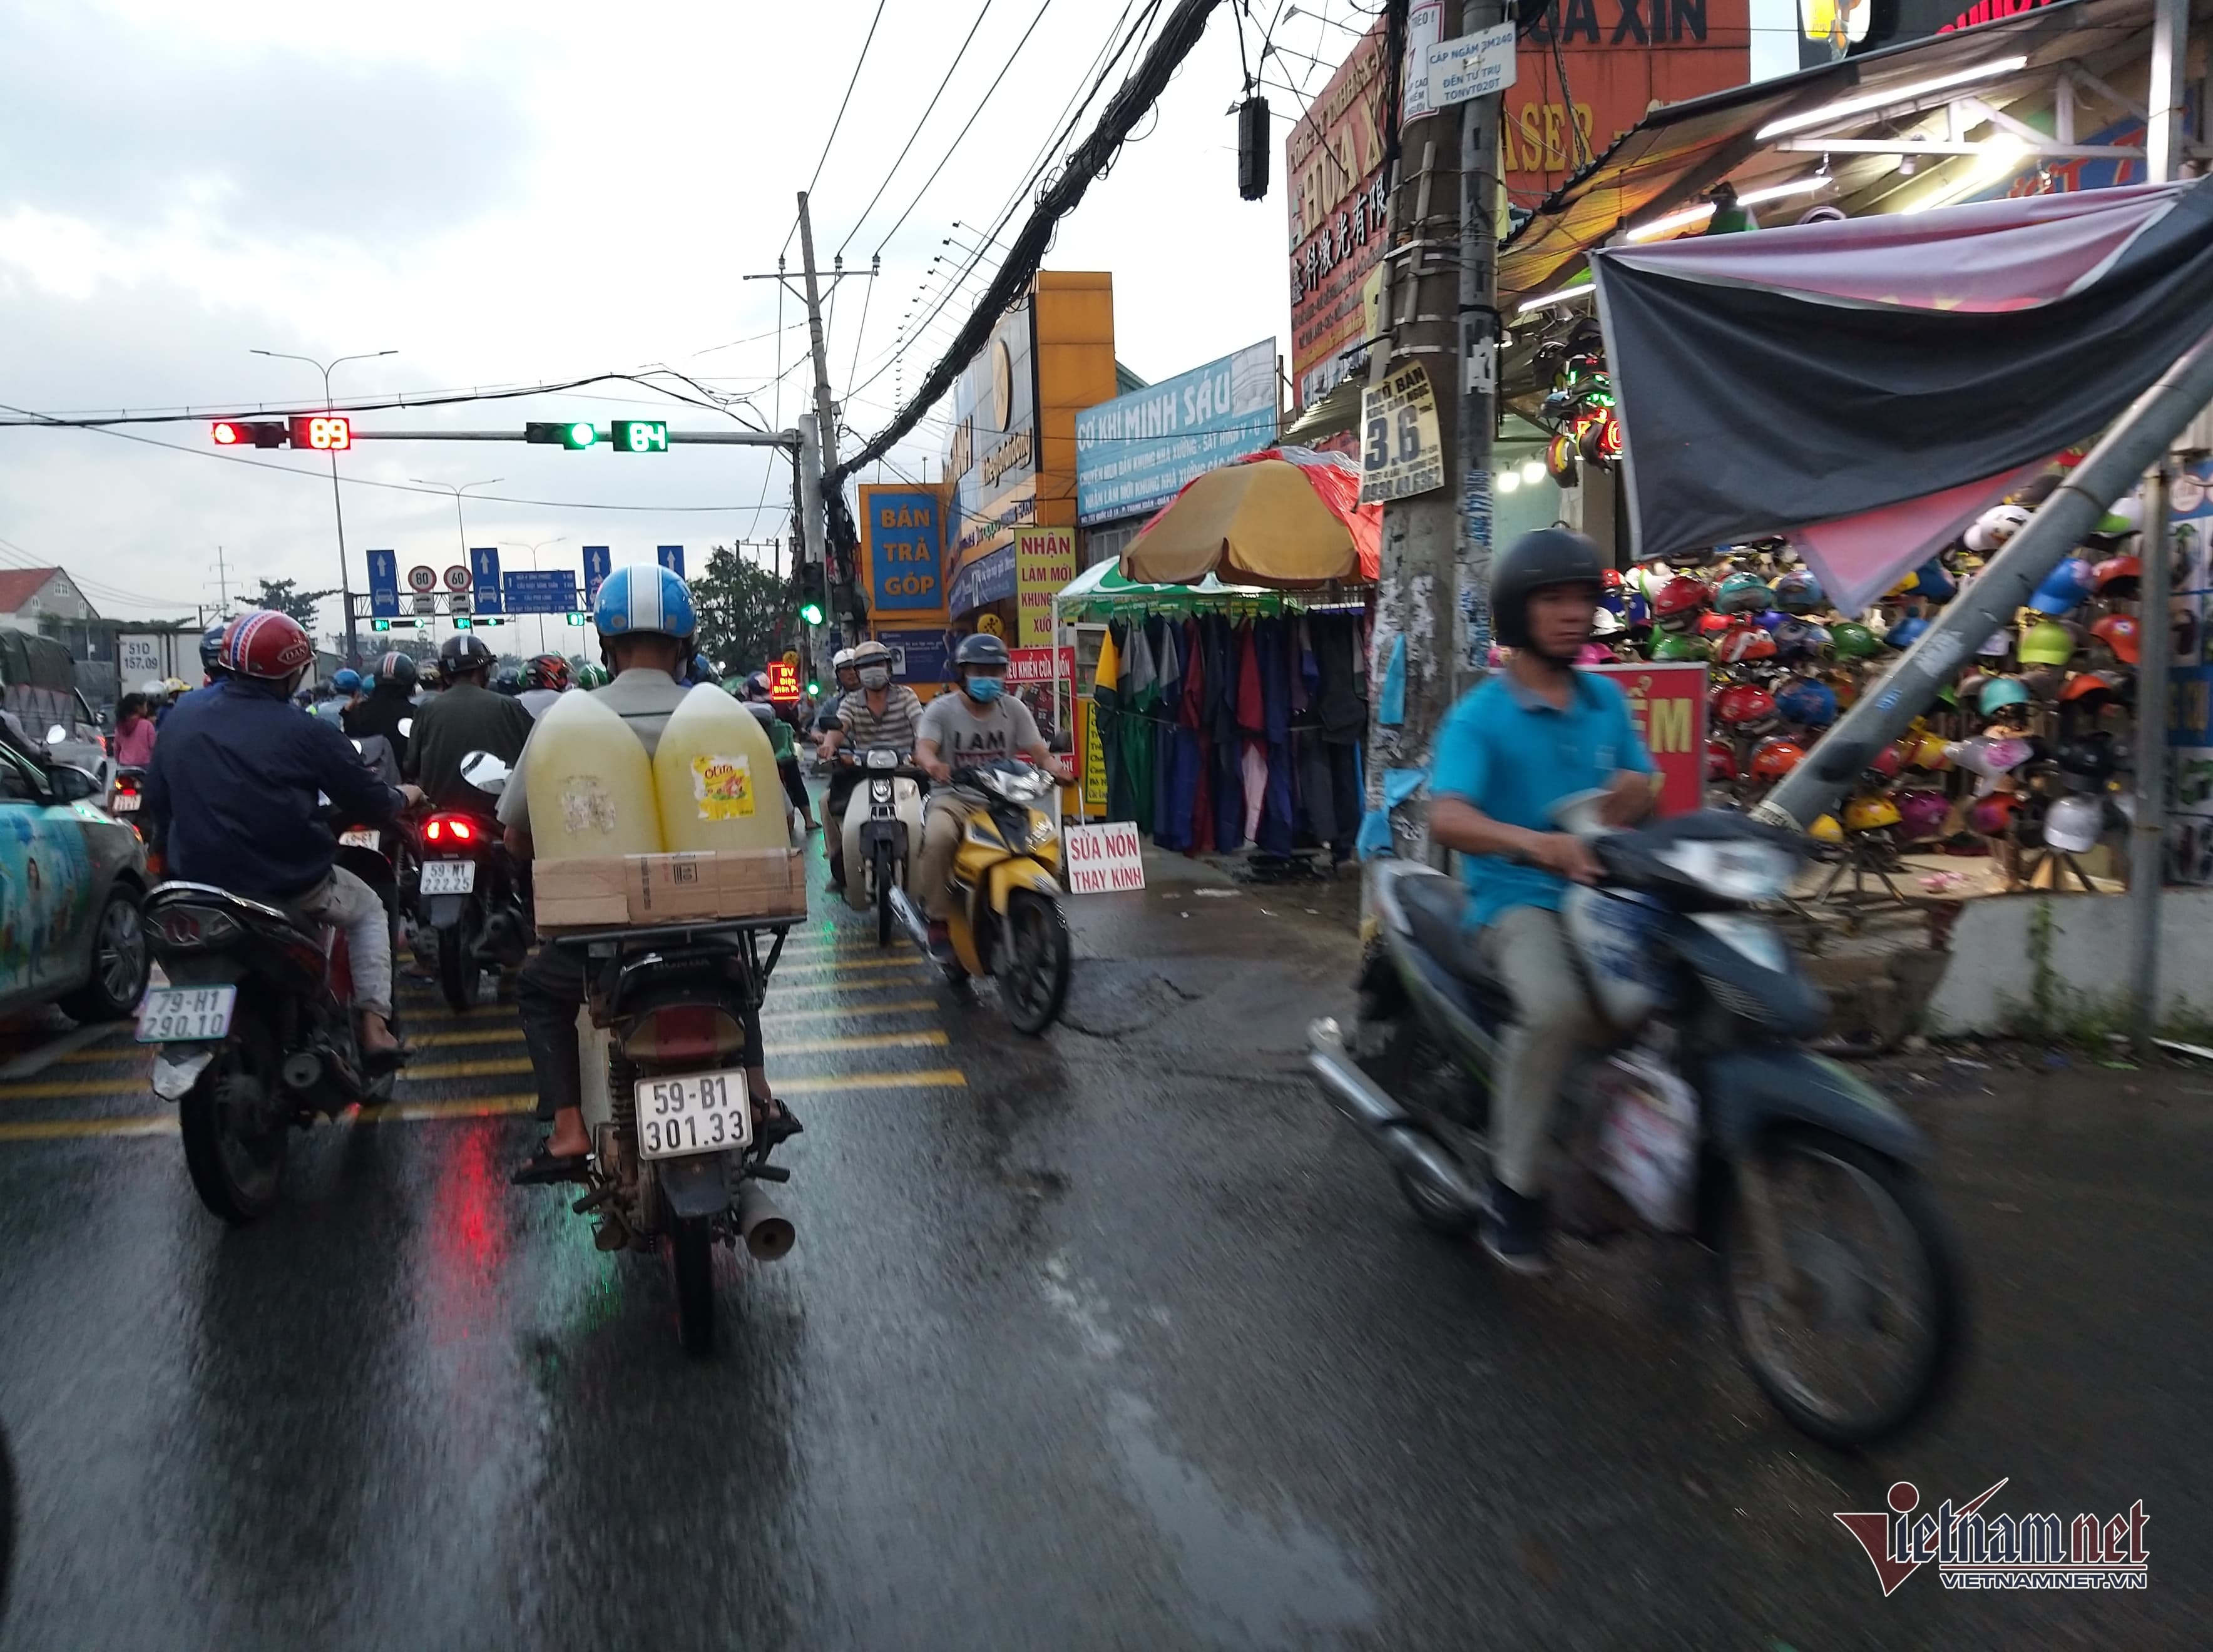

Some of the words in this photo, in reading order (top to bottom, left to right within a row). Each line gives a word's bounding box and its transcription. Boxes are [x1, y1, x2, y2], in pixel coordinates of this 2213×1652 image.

[1126, 391, 1177, 445] MINH
[1183, 368, 1230, 426] SÁU
[310, 418, 349, 449] 89
[630, 422, 665, 452] 84
[881, 503, 931, 528] BÁN
[882, 536, 931, 562] TRẢ
[1021, 532, 1071, 559] NHẬN
[416, 573, 429, 586] 80
[451, 572, 464, 585] 60
[884, 571, 934, 596] GÓP
[1021, 563, 1047, 582] LÀM
[1050, 563, 1072, 582] MỚI
[129, 642, 150, 655] 51D
[125, 656, 158, 670] 157.09
[780, 667, 794, 677] BV
[954, 730, 961, 750] I
[970, 730, 1006, 750] AM
[1073, 868, 1106, 893] THAY
[1110, 862, 1143, 889] KÍNH
[653, 1077, 728, 1114] 59-B1
[646, 1111, 744, 1151] 301.33
